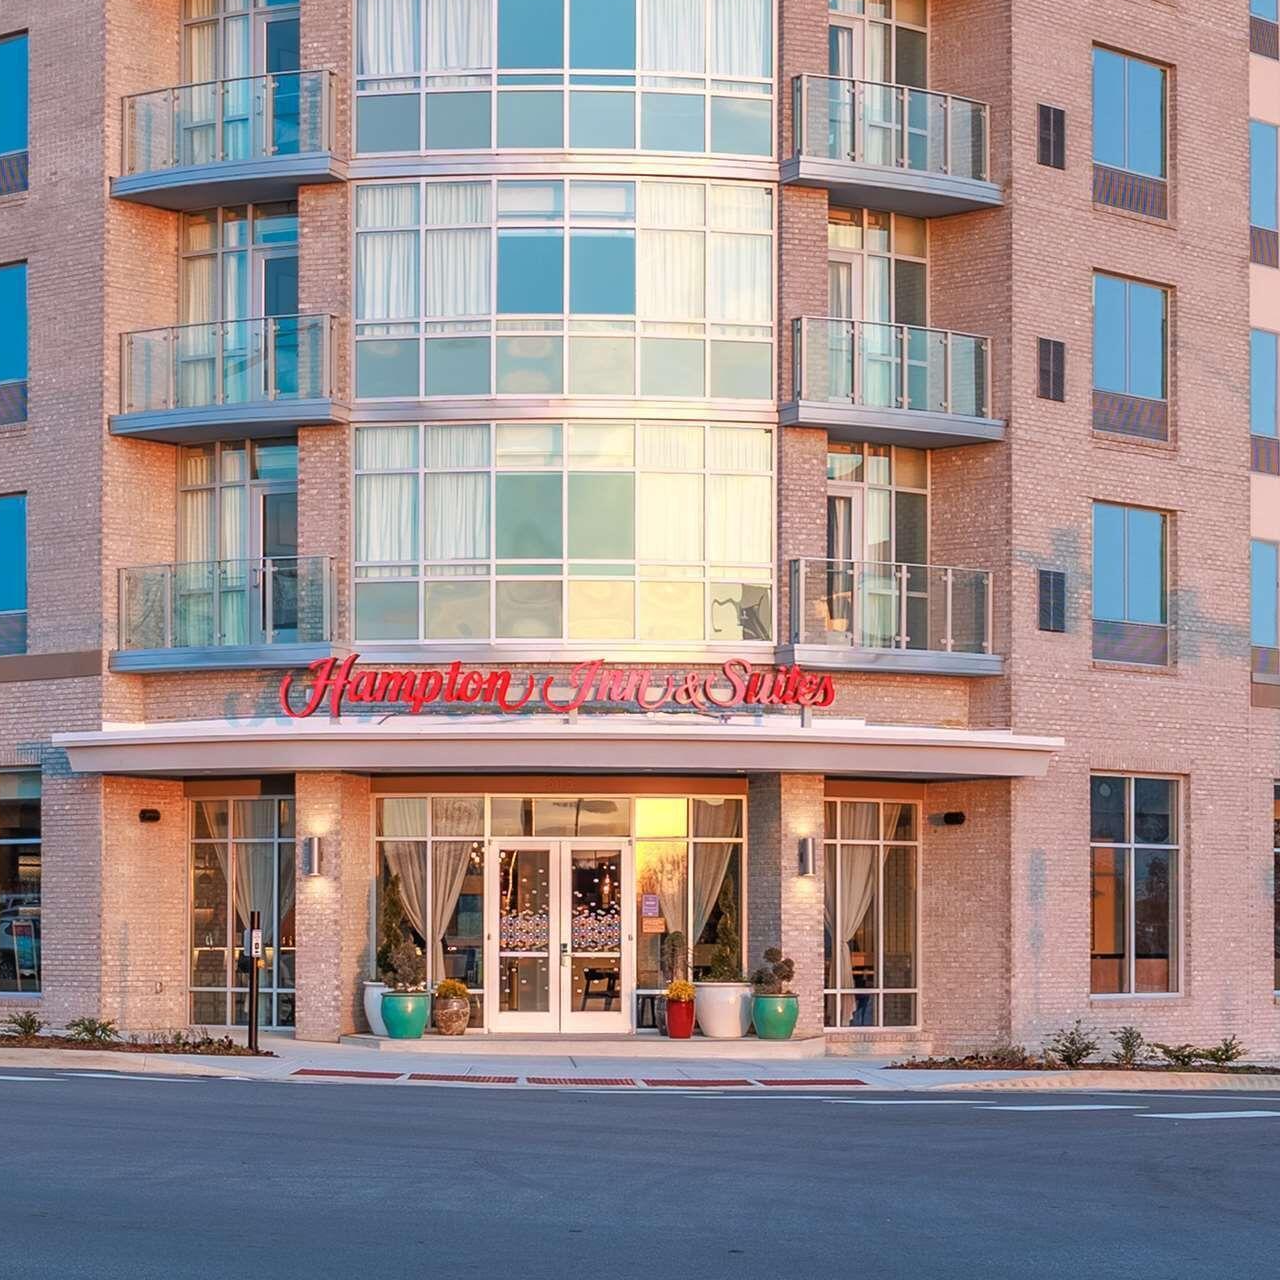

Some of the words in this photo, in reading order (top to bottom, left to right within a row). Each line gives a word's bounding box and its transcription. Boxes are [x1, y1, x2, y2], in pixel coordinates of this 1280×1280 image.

[279, 654, 535, 718] Hampton
[542, 658, 673, 713] Inn
[675, 672, 707, 710] &
[704, 658, 837, 708] Suites
